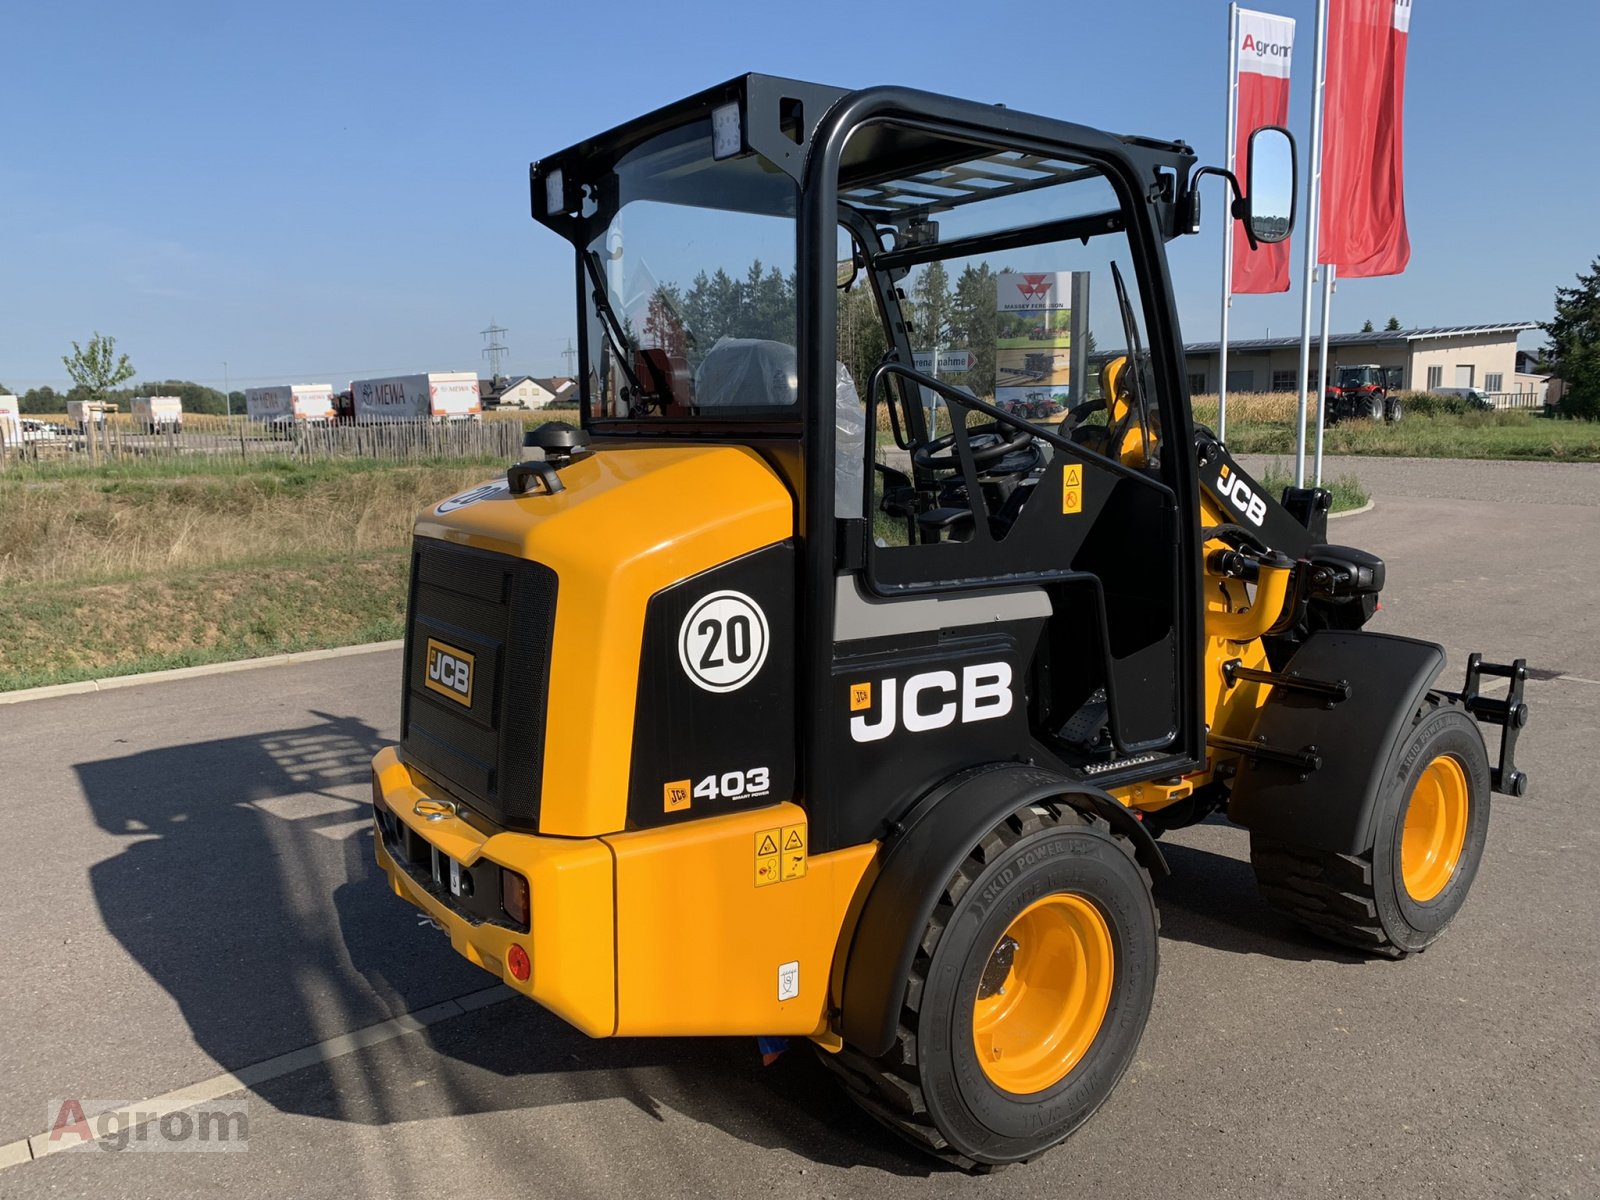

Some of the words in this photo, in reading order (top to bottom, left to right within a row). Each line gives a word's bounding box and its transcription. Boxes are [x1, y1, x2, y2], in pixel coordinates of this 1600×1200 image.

[1242, 34, 1291, 57] Agrom
[375, 383, 406, 406] MEWA
[450, 486, 502, 505] 20
[1217, 472, 1267, 526] JCB
[698, 614, 751, 670] 20
[429, 652, 469, 693] JCB
[850, 661, 1013, 743] JCB
[671, 789, 686, 803] JCB
[693, 767, 770, 800] 403
[983, 869, 1014, 902] SKID
[1016, 840, 1064, 873] POWER
